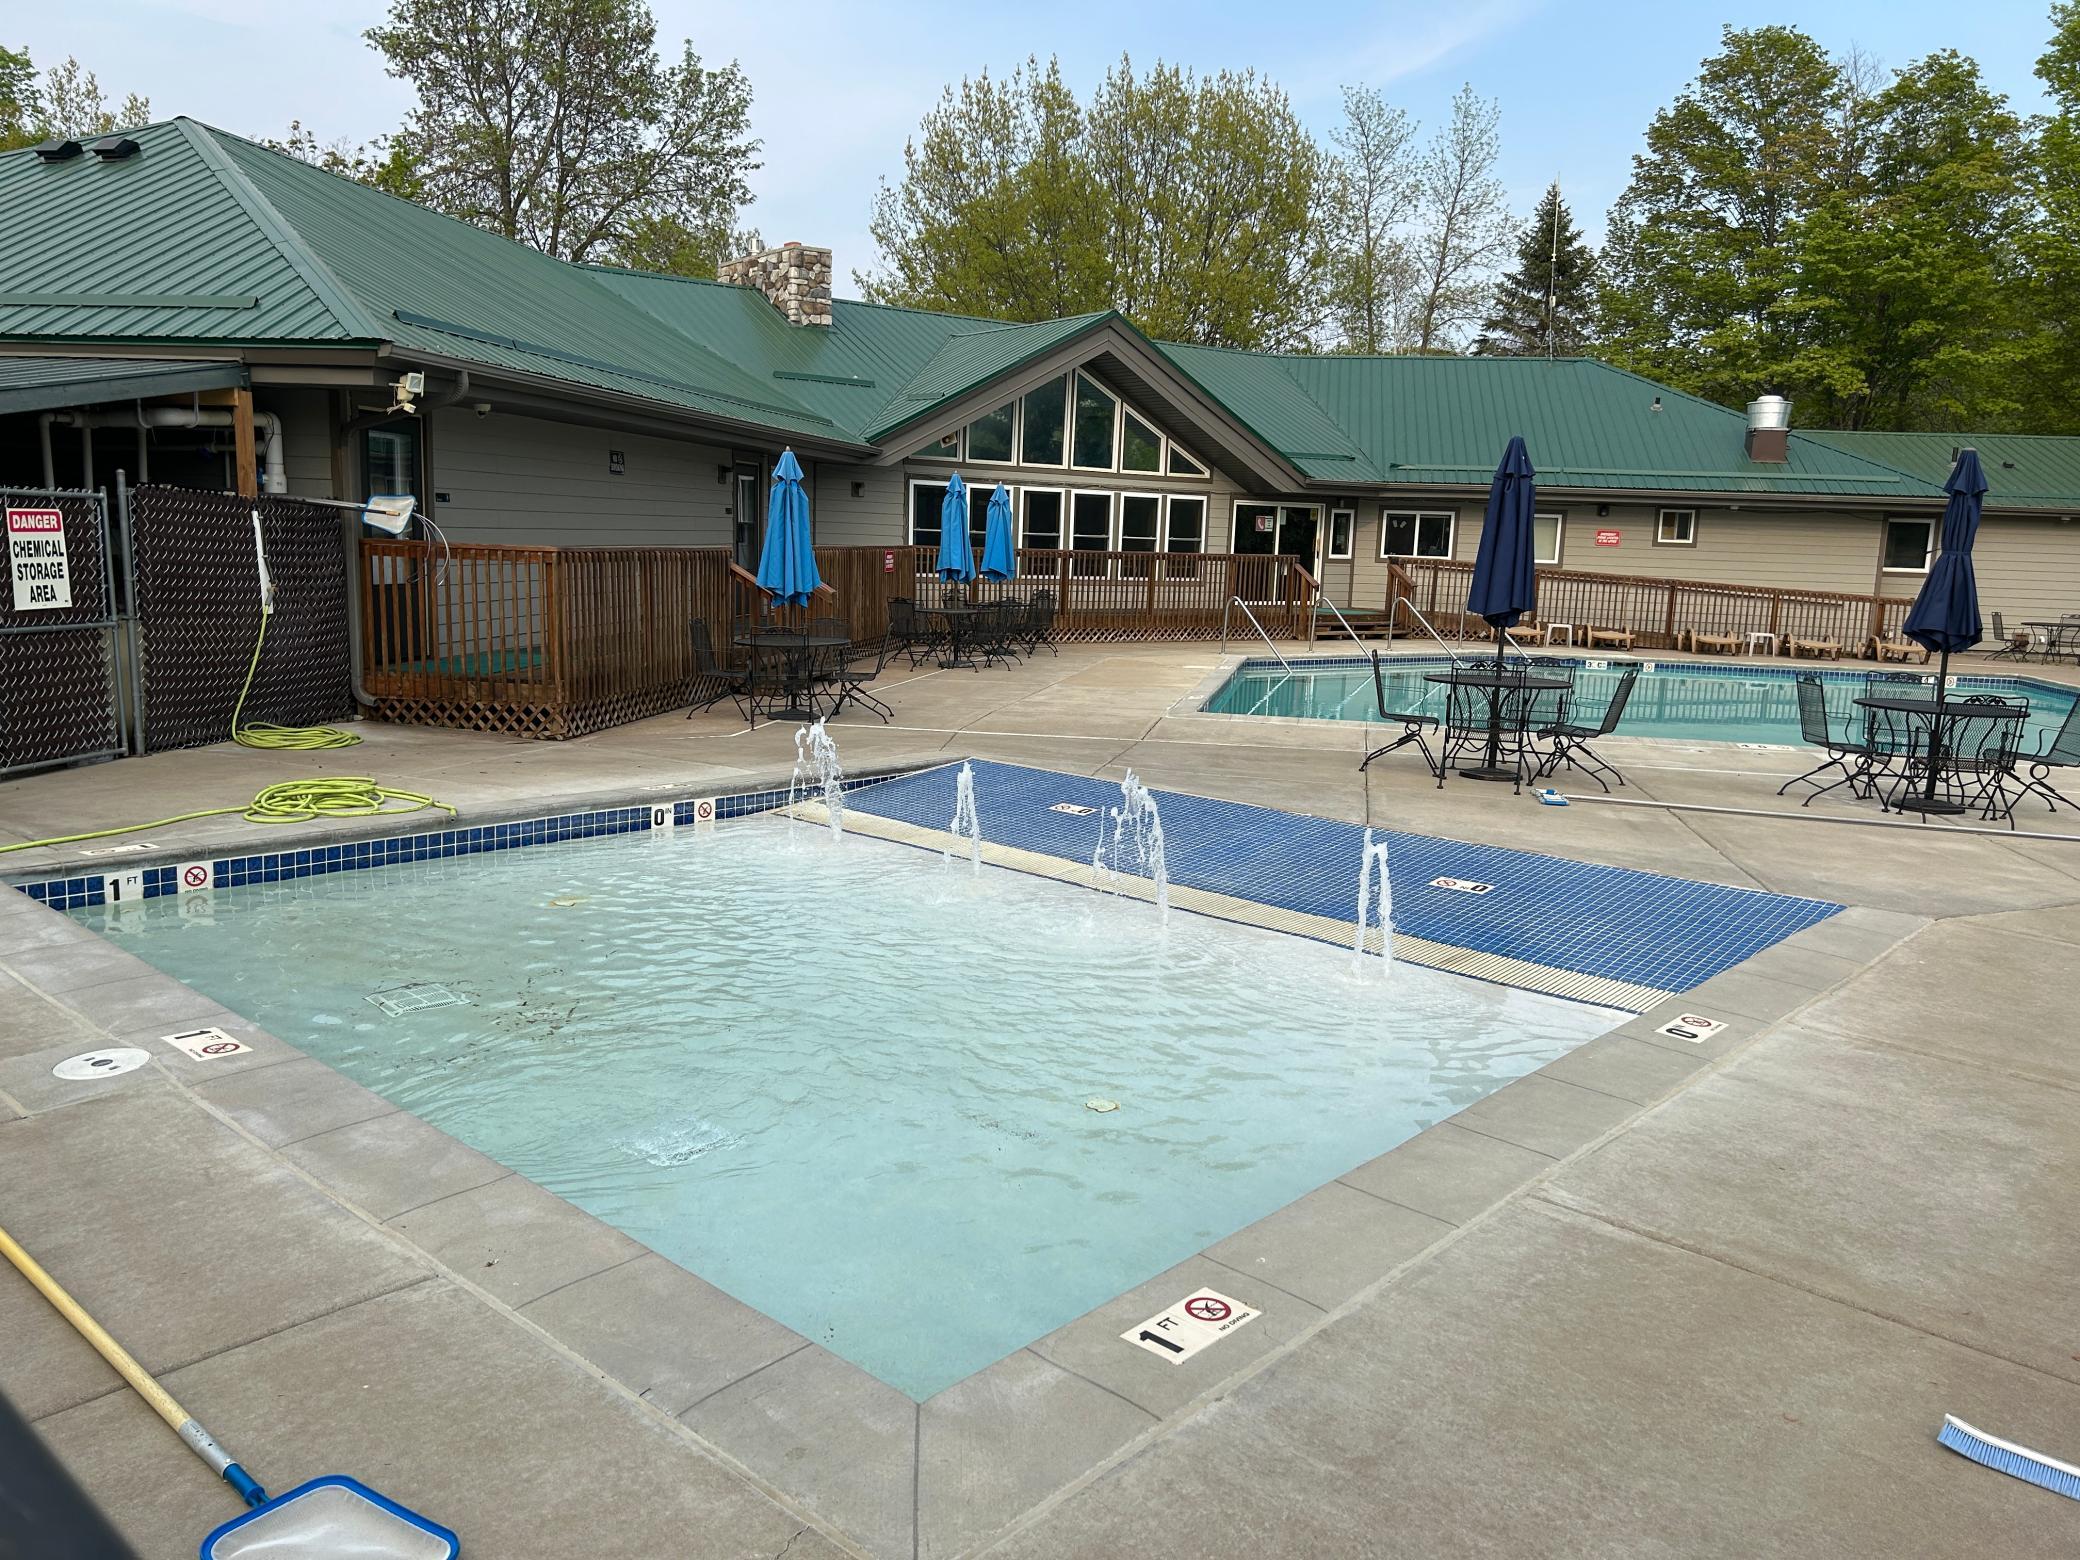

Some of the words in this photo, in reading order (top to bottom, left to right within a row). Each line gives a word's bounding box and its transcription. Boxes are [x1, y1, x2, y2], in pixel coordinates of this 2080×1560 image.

[12, 514, 58, 529] DANGER
[13, 540, 64, 558] CHEMICAL
[17, 562, 64, 580] STORAGE
[30, 585, 57, 603] AREA
[654, 808, 664, 826] 0
[109, 878, 121, 901] 1
[126, 876, 138, 886] FT
[174, 1030, 212, 1039] 1
[1665, 1028, 1699, 1039] 0
[1156, 1317, 1179, 1331] FT
[1218, 1323, 1230, 1331] NO
[1229, 1312, 1250, 1325] DIVING
[1139, 1330, 1184, 1353] 1
